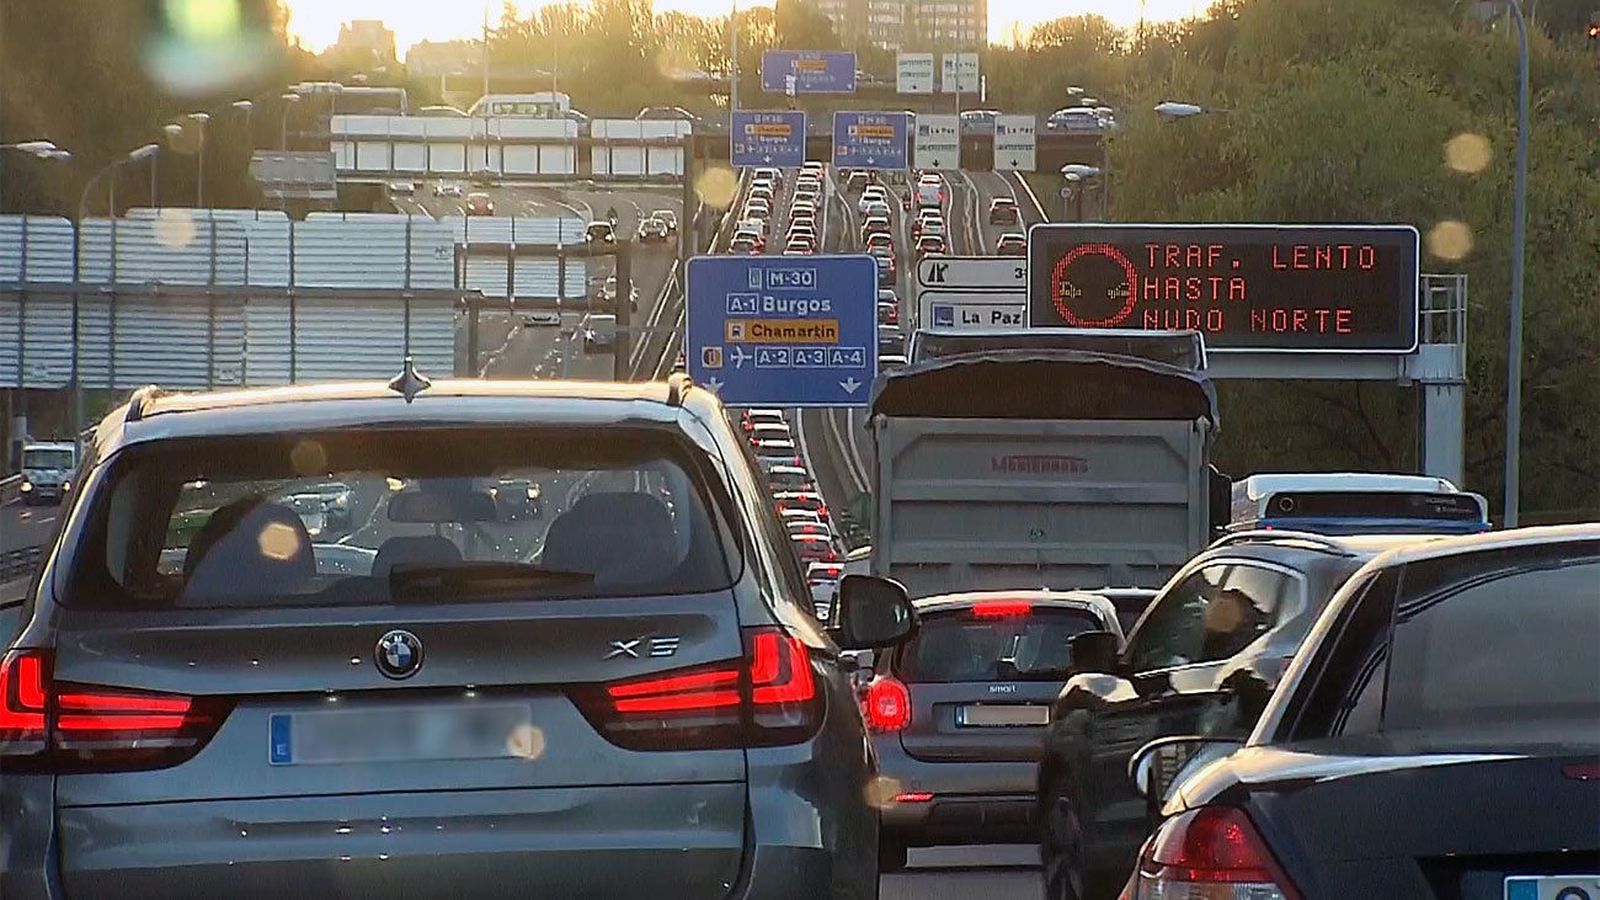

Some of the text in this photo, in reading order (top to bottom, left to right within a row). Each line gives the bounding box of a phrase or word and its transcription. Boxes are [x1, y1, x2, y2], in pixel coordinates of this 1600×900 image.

[1145, 245, 1376, 269] TRAF. LENTO
[770, 271, 812, 286] M-30
[1143, 277, 1245, 300] HASTA
[730, 296, 831, 316] A-1 Burgos
[962, 310, 1022, 324] La Paz
[1143, 309, 1352, 332] NUDO NORTE
[759, 350, 862, 364] A-2 A-3 A-4
[989, 685, 1016, 694] smart
